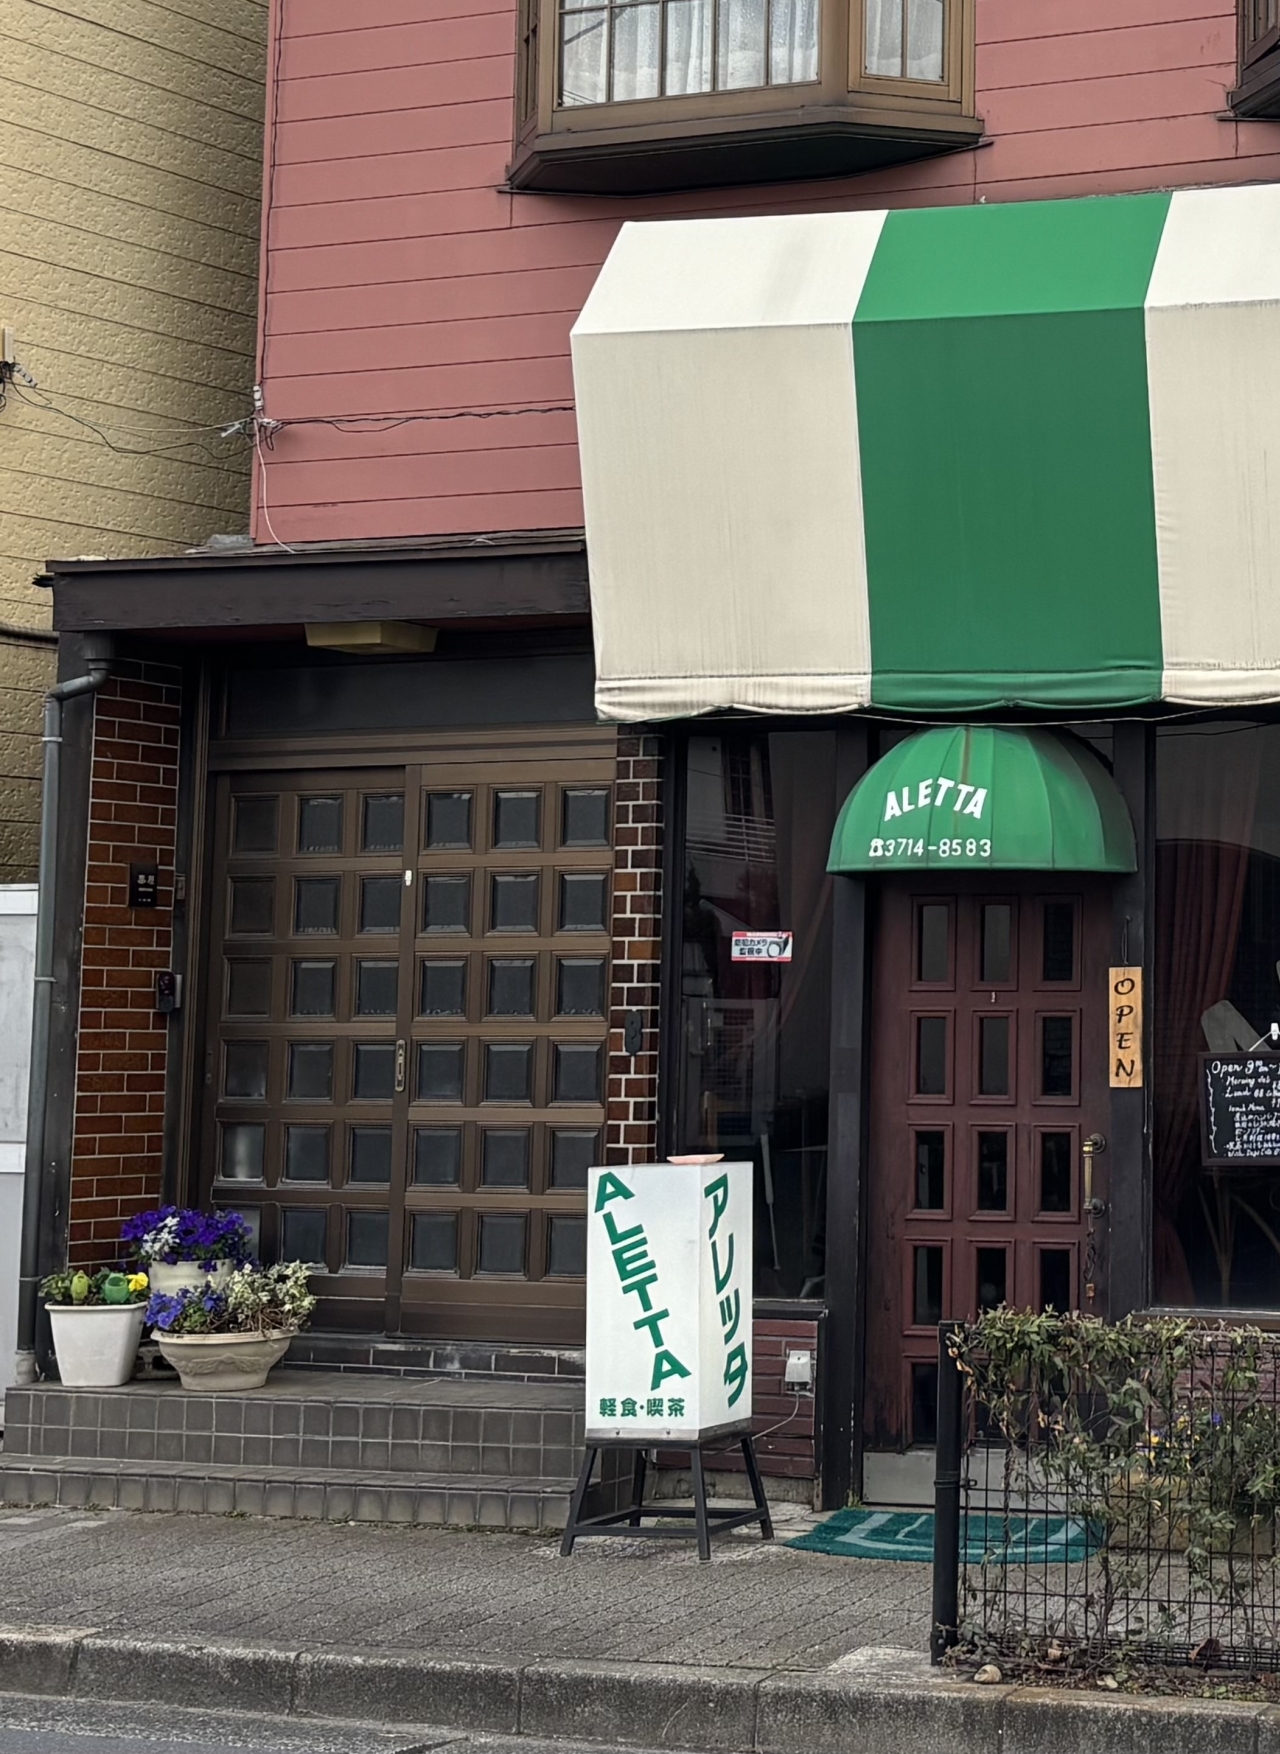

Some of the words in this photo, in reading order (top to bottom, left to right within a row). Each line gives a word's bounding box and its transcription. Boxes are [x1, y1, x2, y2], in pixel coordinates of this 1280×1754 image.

[884, 777, 988, 822] ALETTA
[885, 838, 992, 857] 3714-8583
[1114, 978, 1135, 1077] OPEN
[1211, 1061, 1243, 1078] Open
[594, 1171, 692, 1391] ALETTA
[704, 1173, 748, 1408] アレッタ
[599, 1397, 685, 1417] 軽食・喫茶
